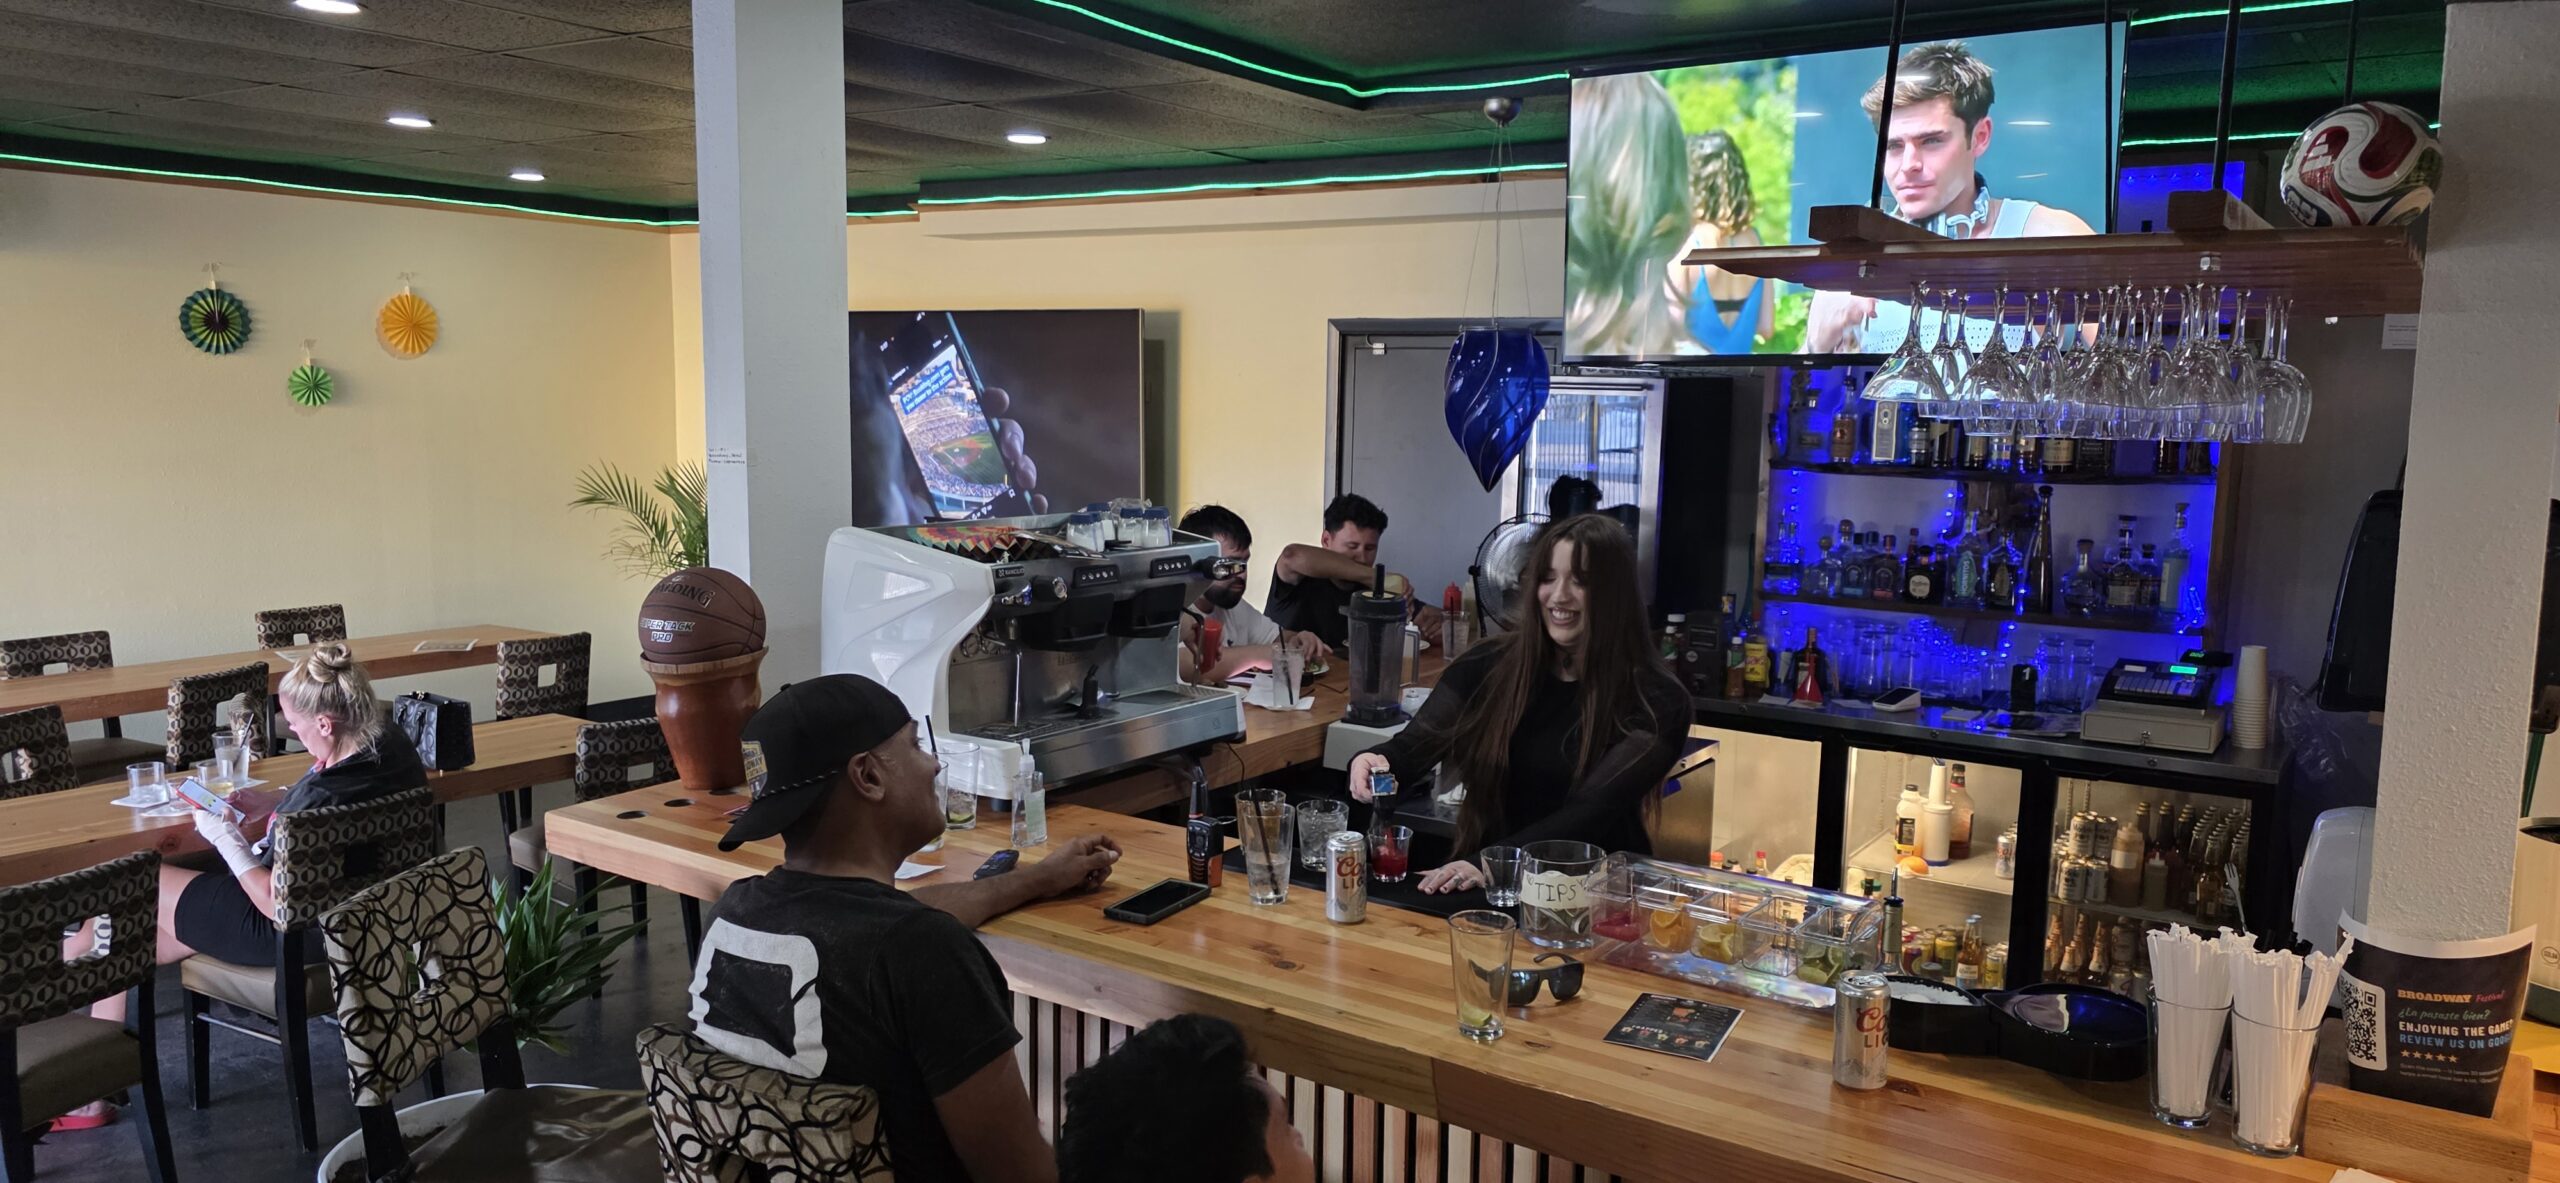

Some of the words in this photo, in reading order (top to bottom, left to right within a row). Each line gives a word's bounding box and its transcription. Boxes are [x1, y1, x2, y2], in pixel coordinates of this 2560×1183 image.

[656, 582, 715, 609] ALDING
[663, 620, 695, 632] TACK
[651, 631, 673, 643] PRO
[2022, 667, 2031, 681] 1
[1534, 882, 1577, 902] TIPS
[2397, 989, 2473, 1003] BROADWAY
[2475, 990, 2505, 1002] Festival
[2420, 1010, 2460, 1020] pasaste
[2462, 1009, 2492, 1020] bien?
[2399, 1021, 2459, 1036] ENJOYING
[2463, 1027, 2486, 1036] THE
[2488, 1019, 2513, 1035] GAME?
[2400, 1034, 2444, 1047] REVIEW
[2449, 1039, 2465, 1049] US
[2469, 1039, 2485, 1049] ON
